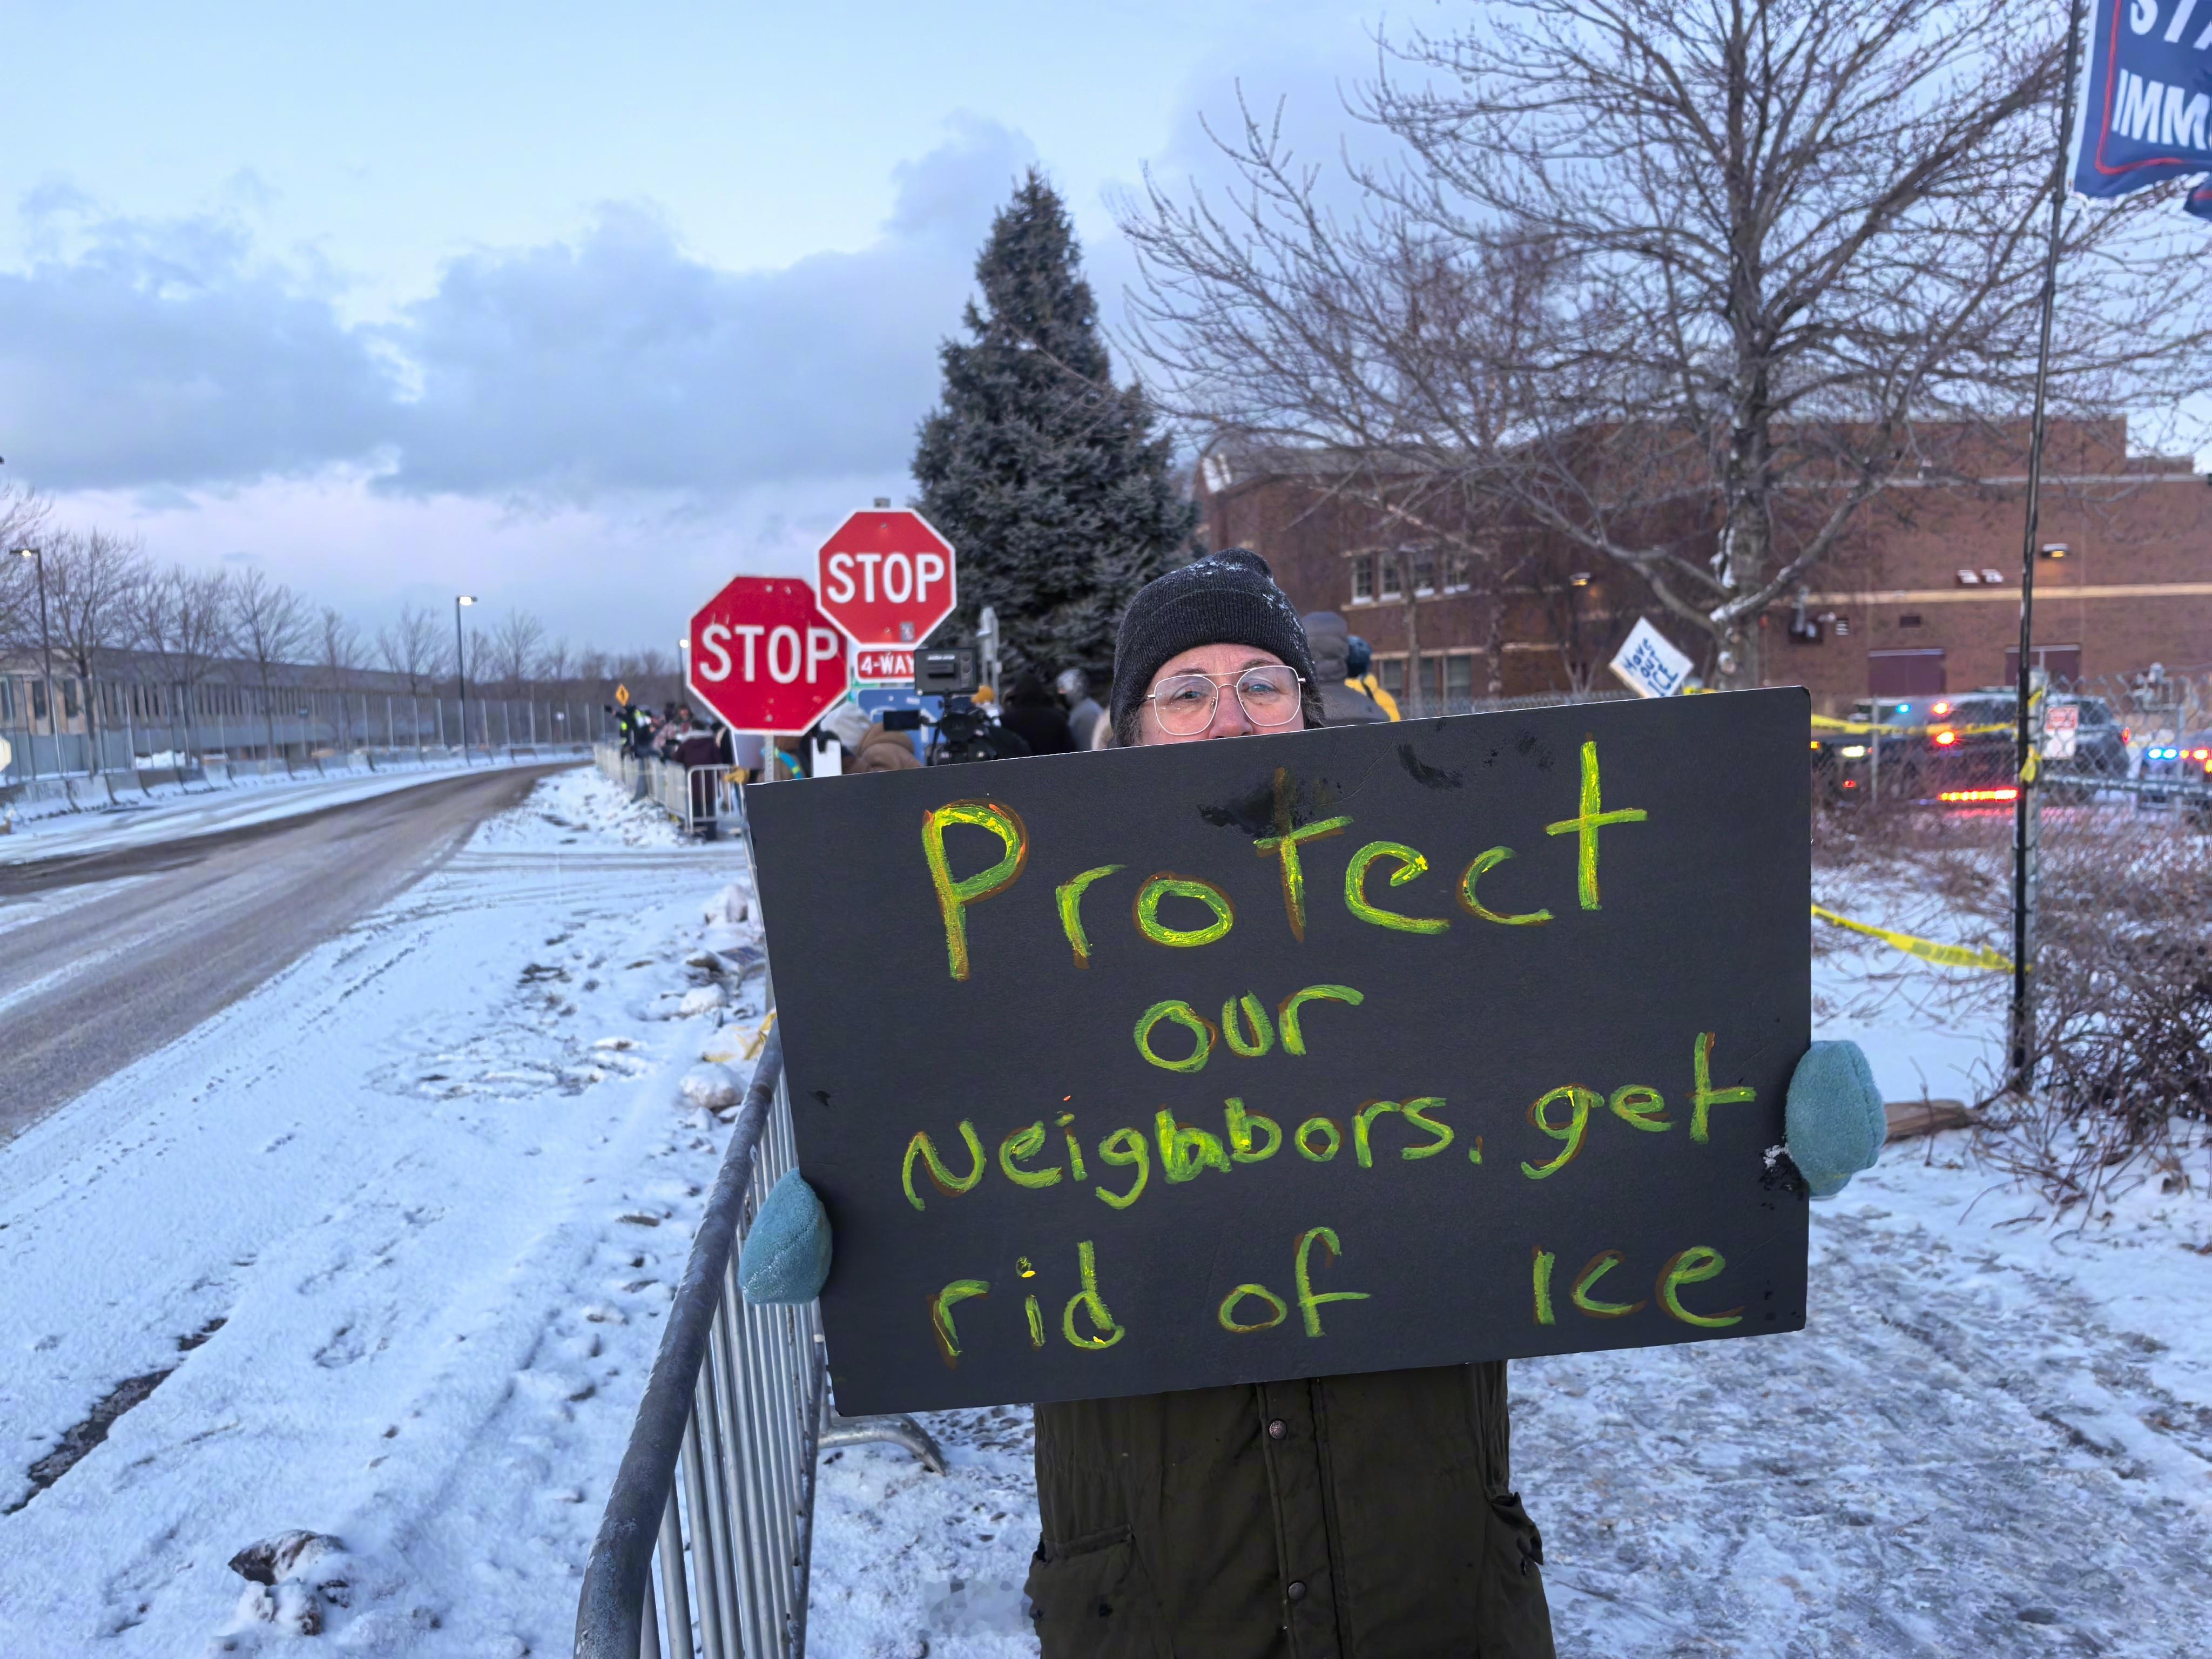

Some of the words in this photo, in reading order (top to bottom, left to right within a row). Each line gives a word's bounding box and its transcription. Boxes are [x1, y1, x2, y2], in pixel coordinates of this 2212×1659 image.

[2112, 68, 2212, 151] IMM
[827, 552, 945, 603] STOP
[700, 624, 839, 684] STOP
[1134, 984, 1364, 1073] our
[1521, 1031, 1757, 1179] get
[928, 1240, 1124, 1369] rid
[1218, 1226, 1371, 1338] of
